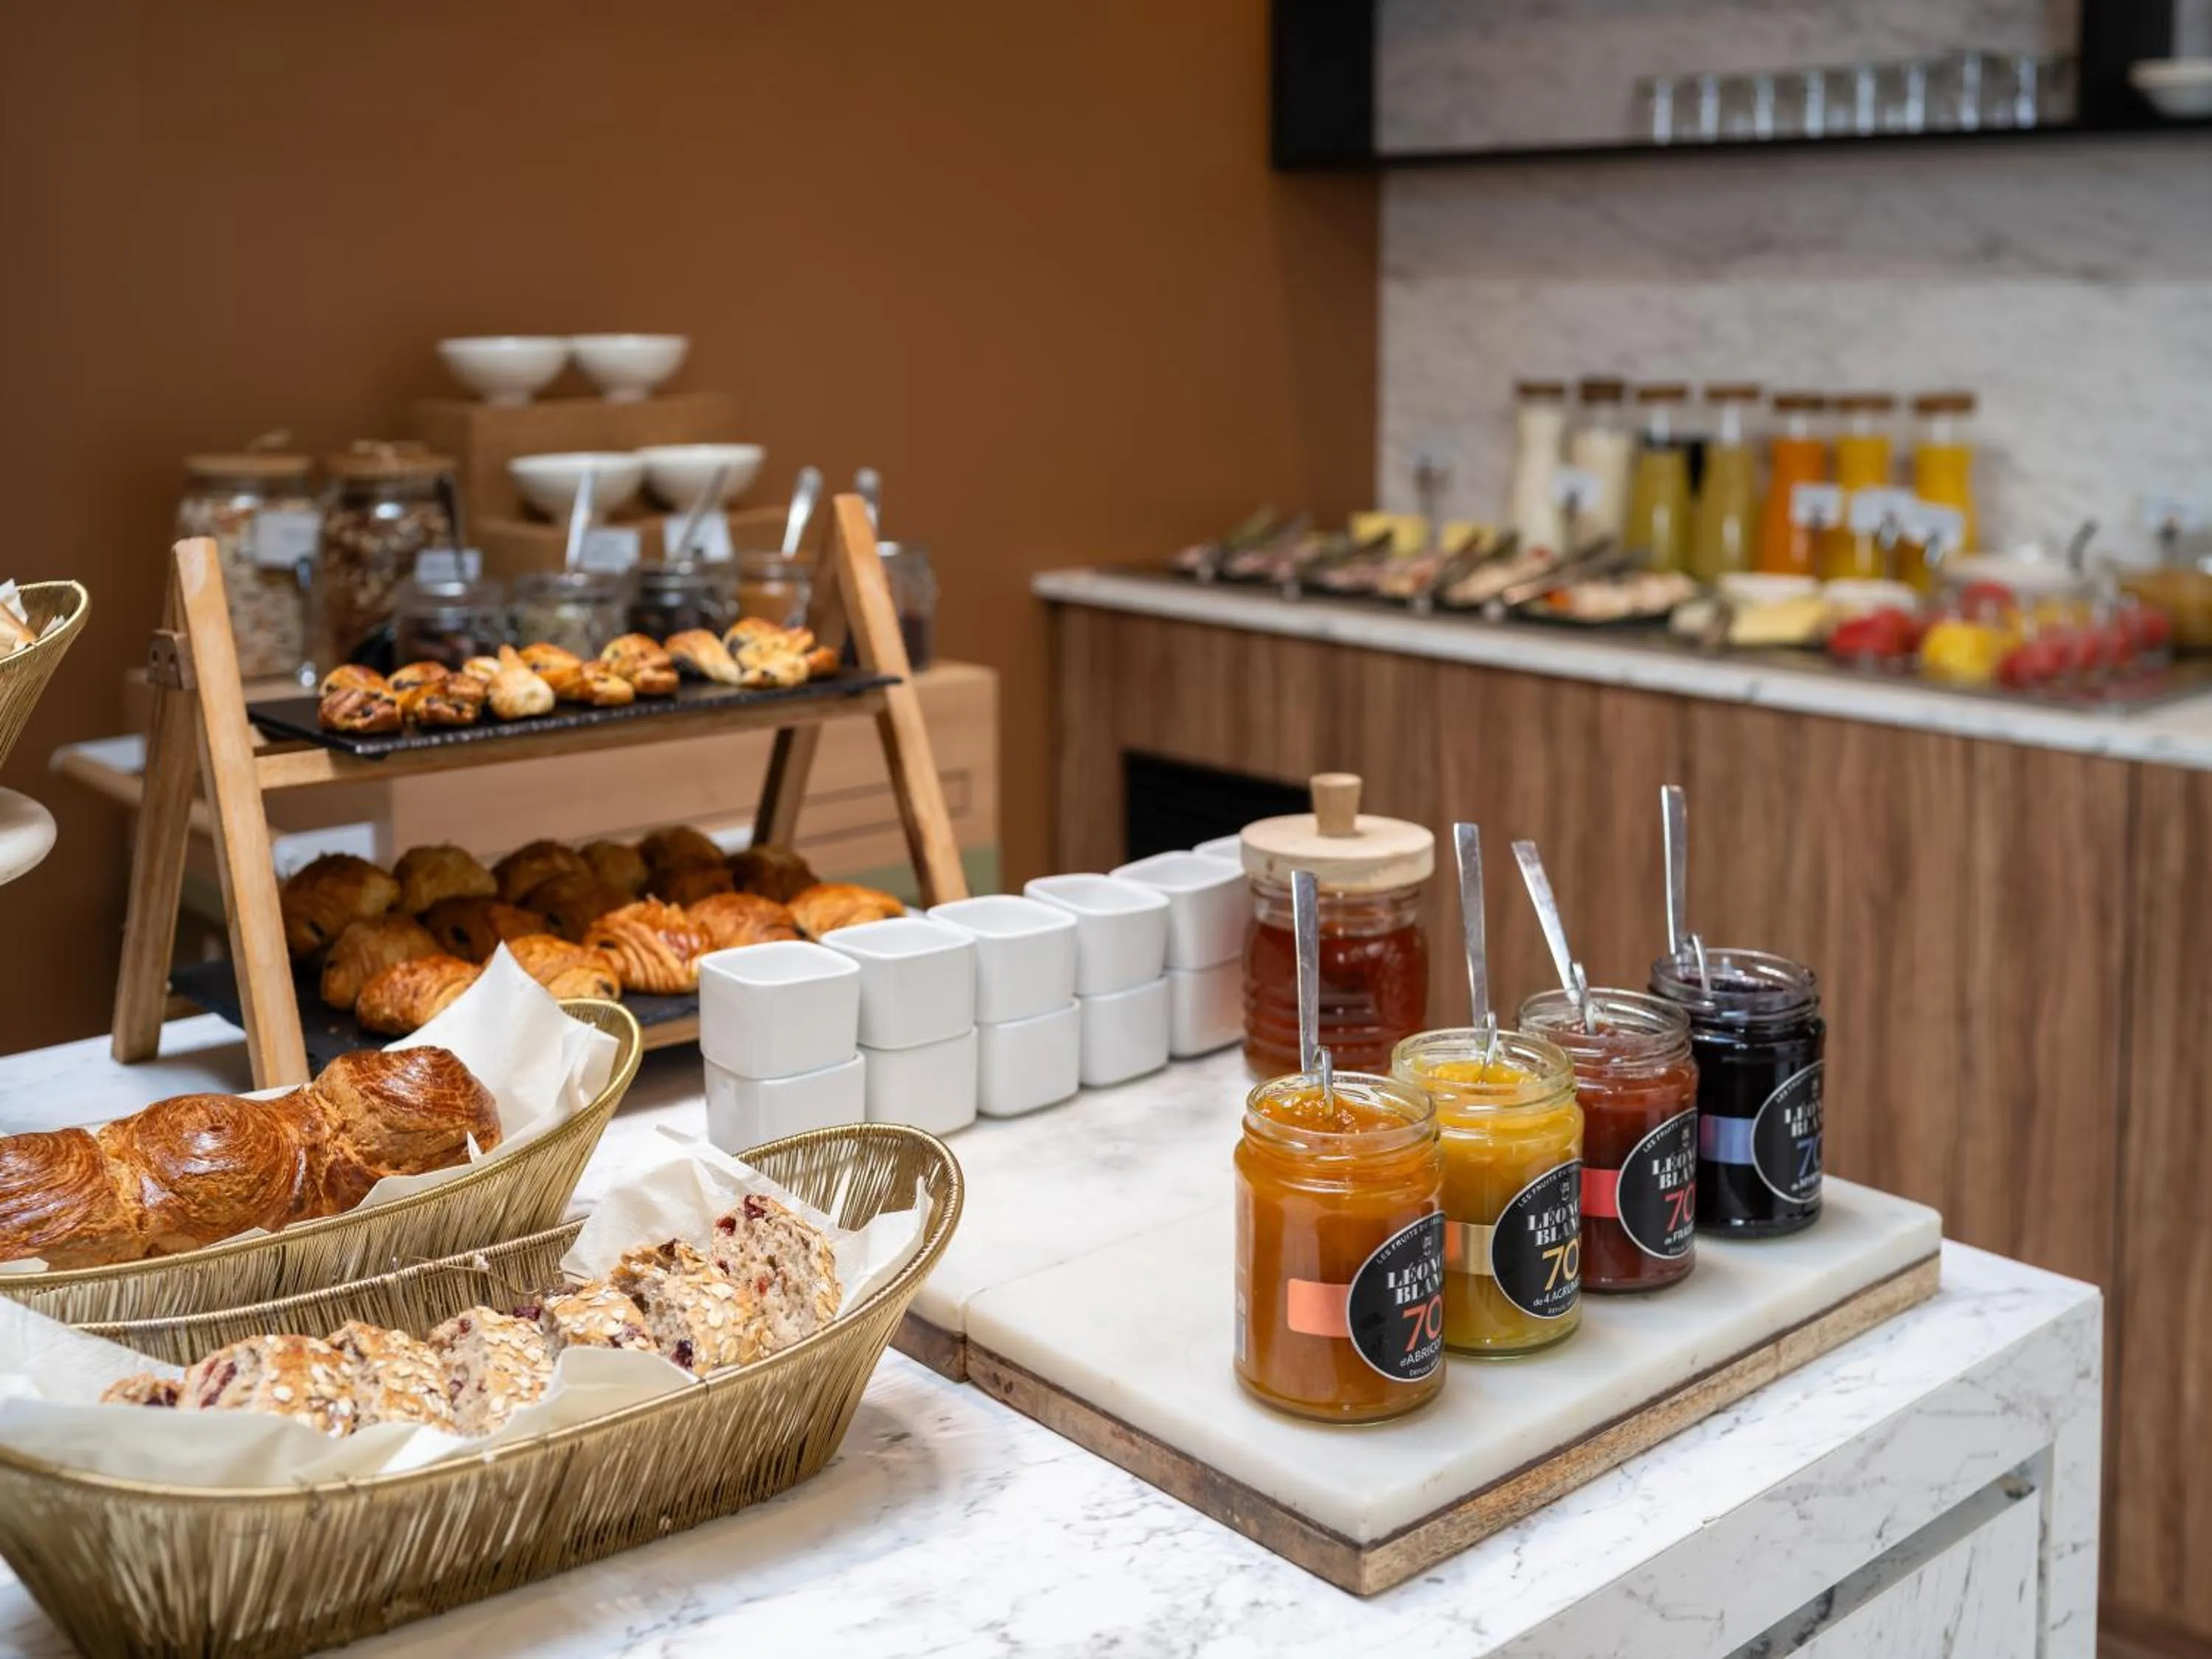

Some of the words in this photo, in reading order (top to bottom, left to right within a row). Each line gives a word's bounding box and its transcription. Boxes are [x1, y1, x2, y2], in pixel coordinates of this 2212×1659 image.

[1664, 1181, 1695, 1231] 70
[1376, 1248, 1391, 1265] LES
[1533, 1297, 1543, 1307] de
[1543, 1293, 1550, 1304] 4
[1403, 1294, 1442, 1352] 70
